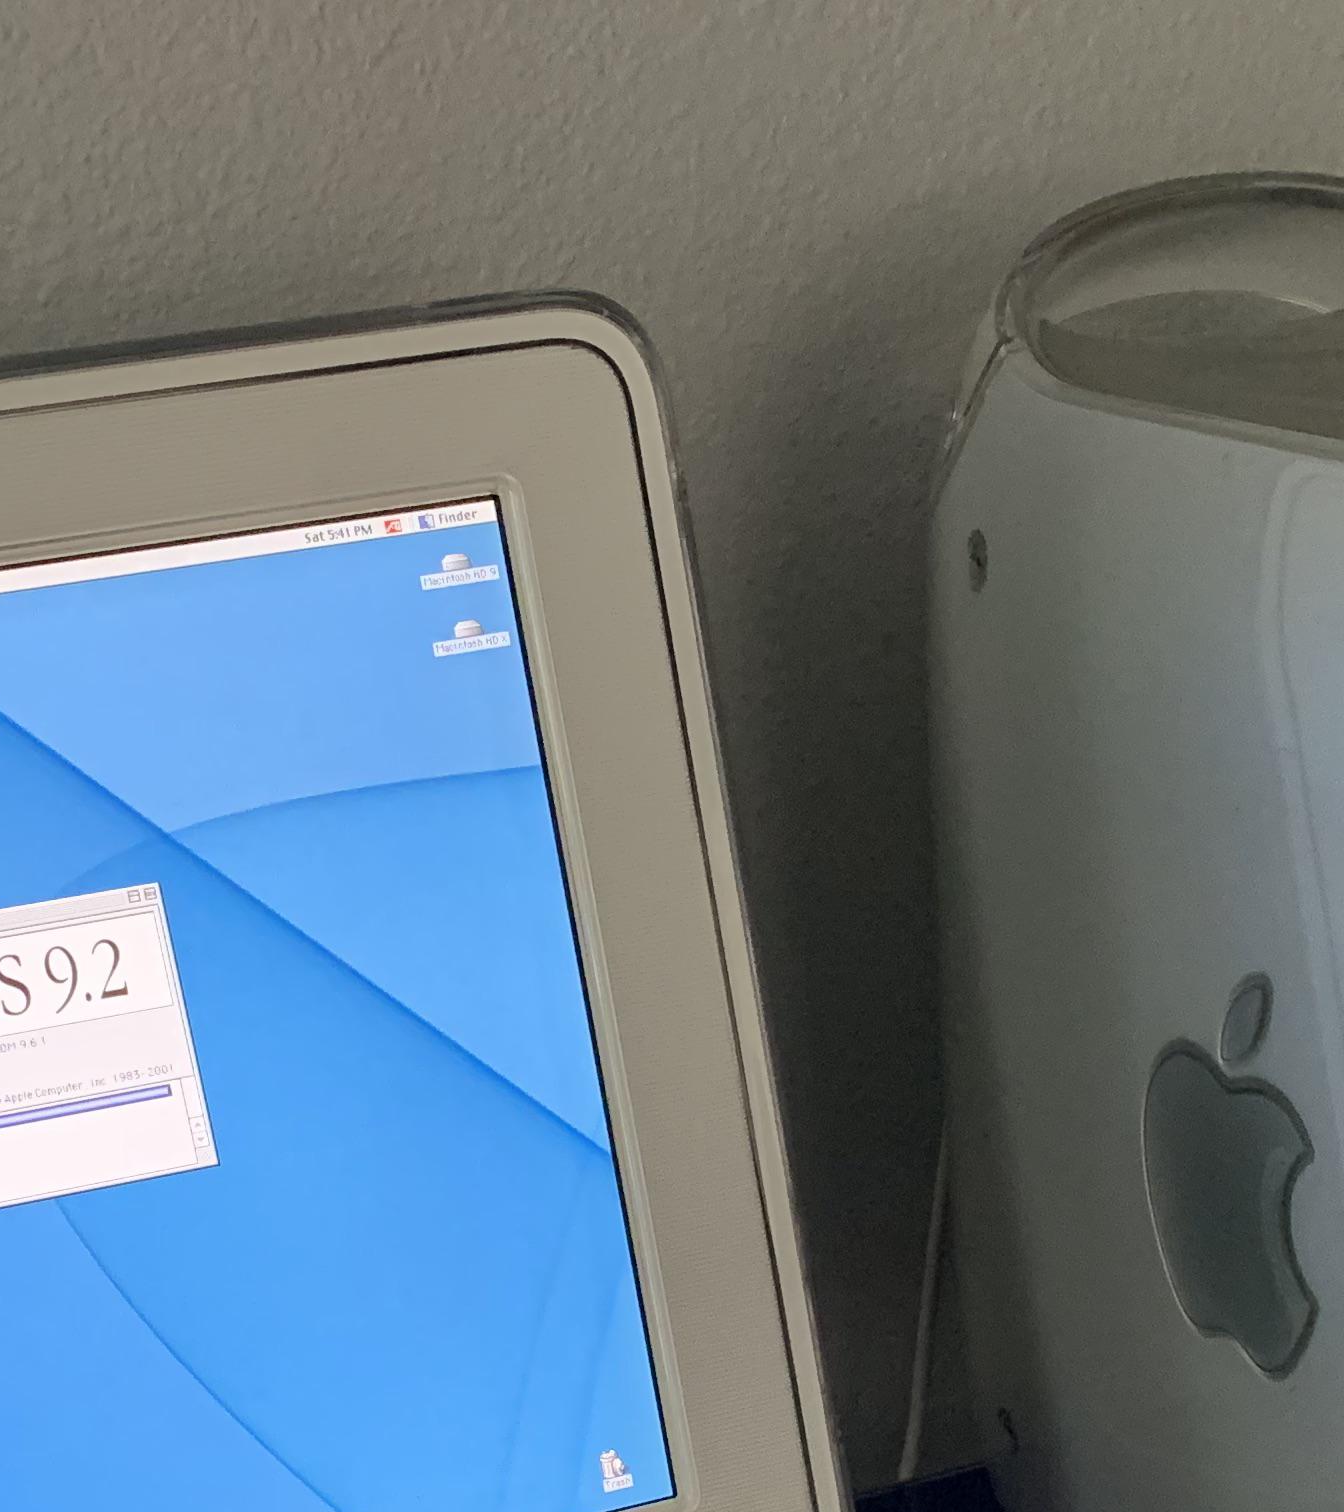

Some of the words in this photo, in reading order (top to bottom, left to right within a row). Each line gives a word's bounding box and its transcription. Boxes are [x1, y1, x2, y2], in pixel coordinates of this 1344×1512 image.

[438, 509, 477, 525] Finder
[304, 532, 324, 544] Sat
[327, 526, 351, 540] 5:41
[354, 524, 373, 536] PM
[44, 938, 129, 1014] 9.2
[19, 1036, 46, 1048] 961
[3, 1091, 32, 1104] Apple
